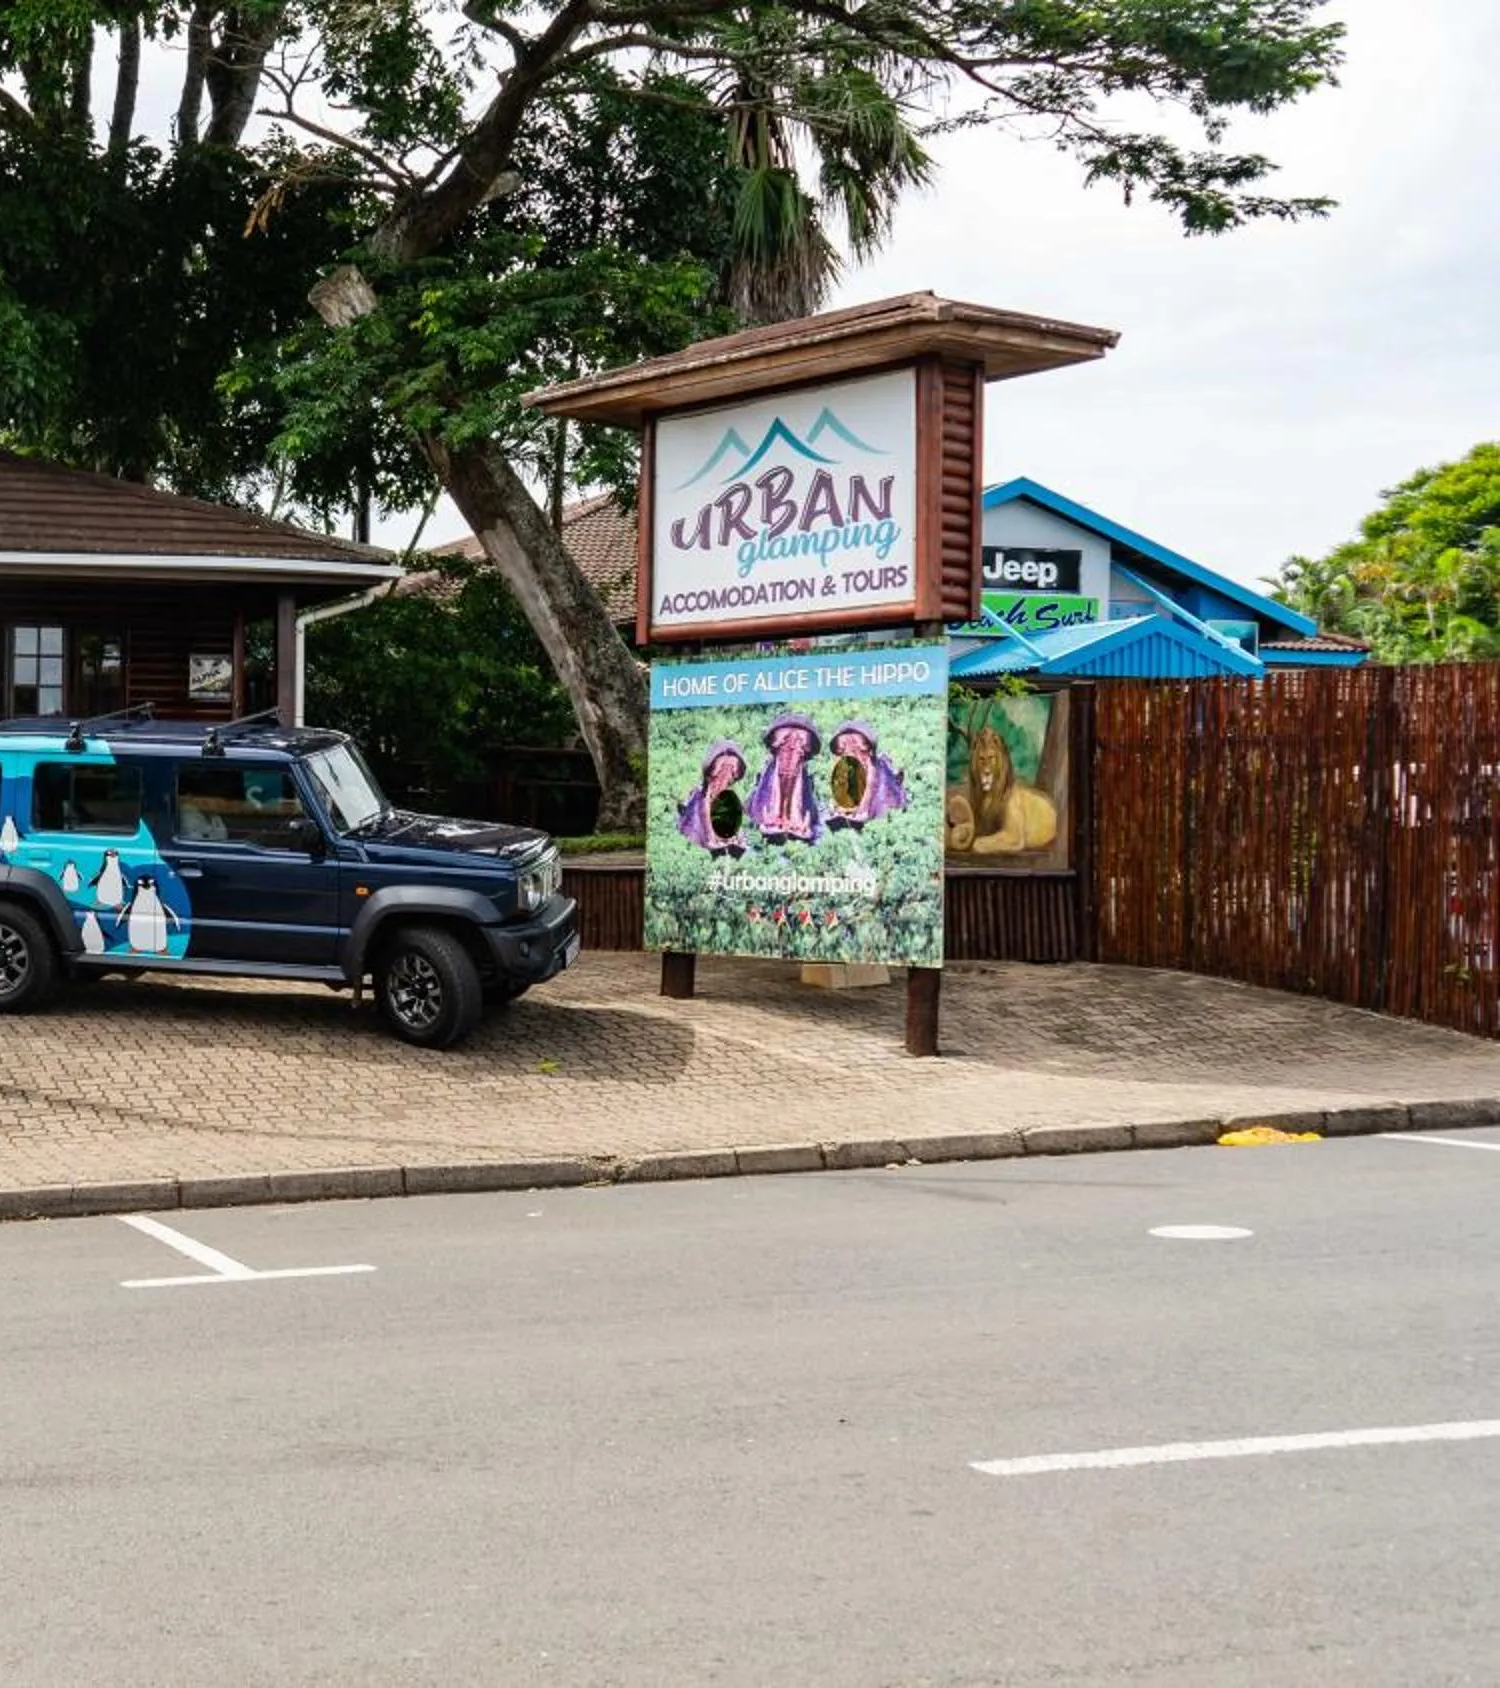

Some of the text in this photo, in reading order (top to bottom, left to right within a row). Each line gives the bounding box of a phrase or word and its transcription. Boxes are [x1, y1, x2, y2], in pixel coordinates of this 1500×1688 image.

[670, 465, 895, 551] URBAN
[737, 517, 901, 578] glamping
[983, 552, 1058, 588] Jeep
[660, 566, 909, 615] ACCOMODATION & TOURS
[947, 598, 1029, 631] eah
[662, 661, 931, 698] HOME OF ALICE THE HIPPO
[708, 870, 877, 897] #urbanglamping
